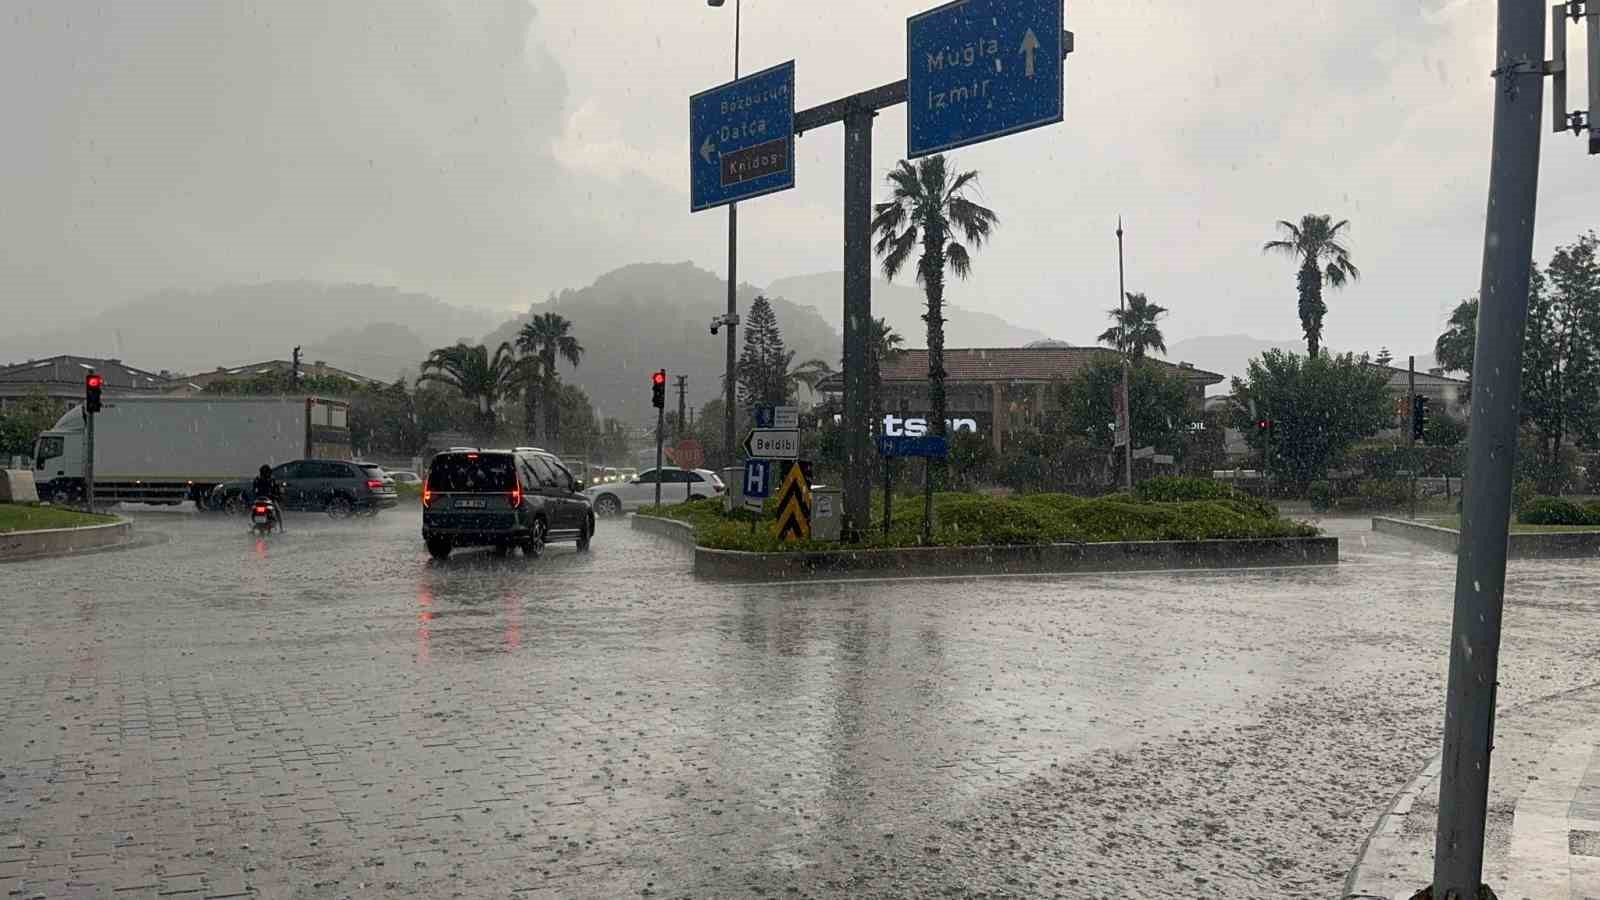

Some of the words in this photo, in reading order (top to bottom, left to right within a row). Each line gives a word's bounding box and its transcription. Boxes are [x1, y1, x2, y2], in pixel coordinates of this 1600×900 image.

[927, 37, 999, 73] Muğla
[928, 79, 992, 110] İzmir
[719, 118, 769, 142] Datça
[729, 152, 779, 176] Knidos
[756, 438, 796, 450] Beldibi
[747, 463, 764, 493] H
